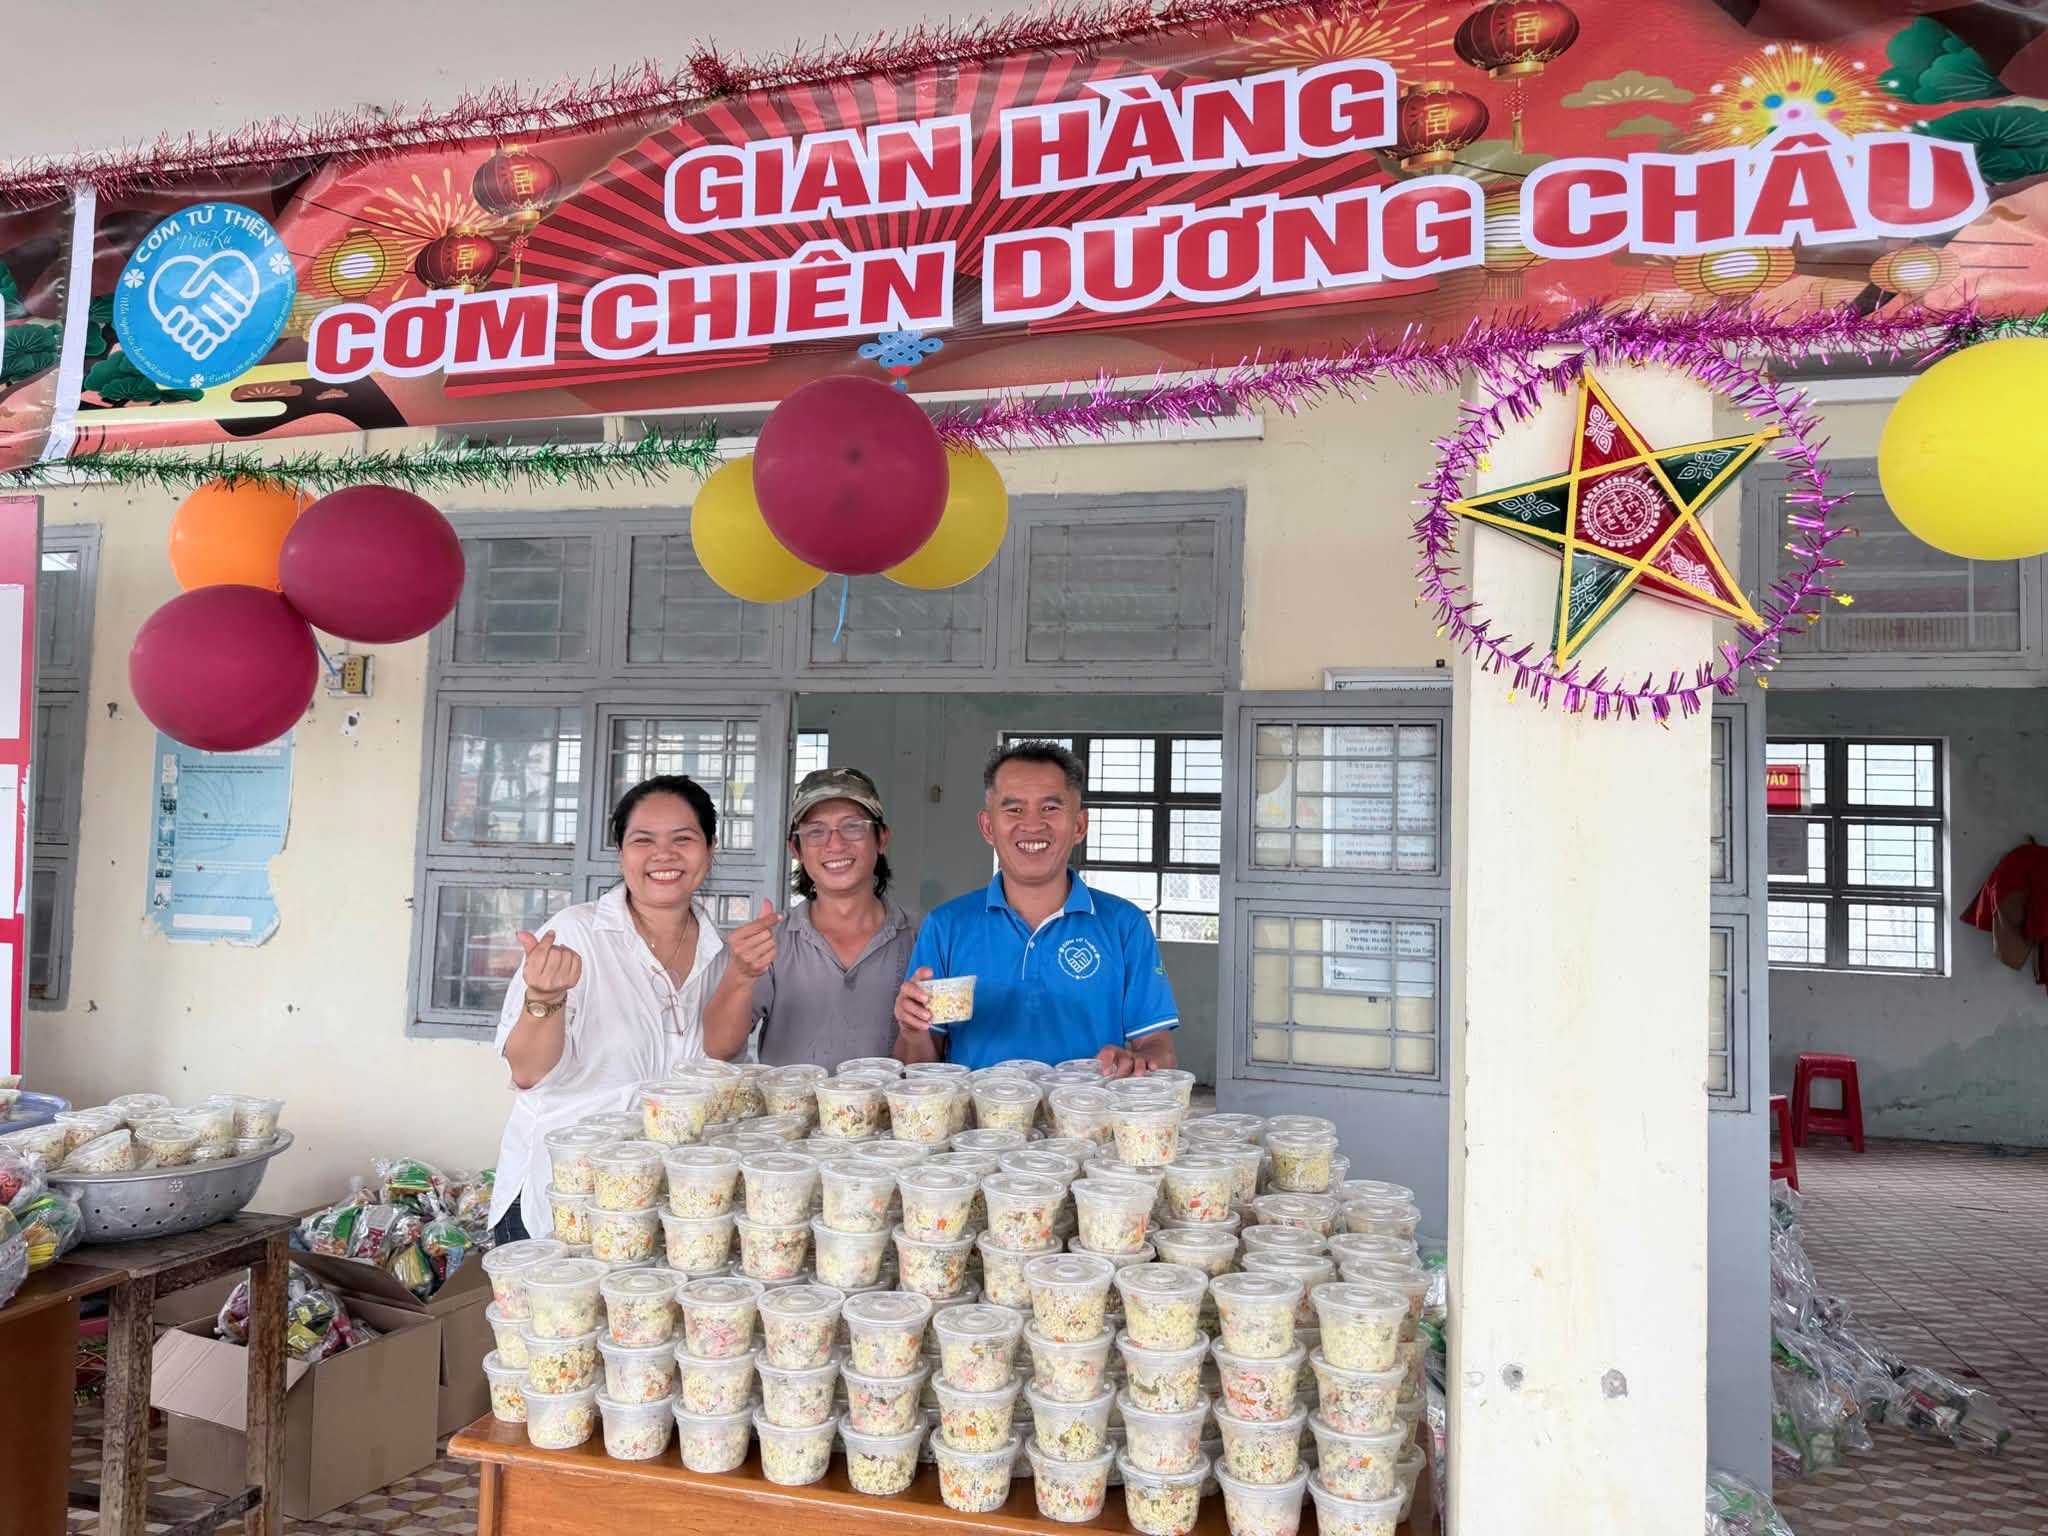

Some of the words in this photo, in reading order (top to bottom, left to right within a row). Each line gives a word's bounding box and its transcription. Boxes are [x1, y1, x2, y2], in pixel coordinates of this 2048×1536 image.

[671, 123, 964, 229] GIAN
[1006, 63, 1390, 190] HÀNG
[136, 218, 182, 263] CƠM
[185, 205, 217, 225] TỪ
[223, 207, 277, 248] THIỆN
[311, 289, 556, 377] CƠM
[586, 245, 948, 355] CHIÊN
[990, 182, 1482, 315] DƯƠNG
[1541, 130, 1978, 252] CHÂU
[1598, 503, 1619, 531] THU
[1606, 492, 1637, 531] TRUNG
